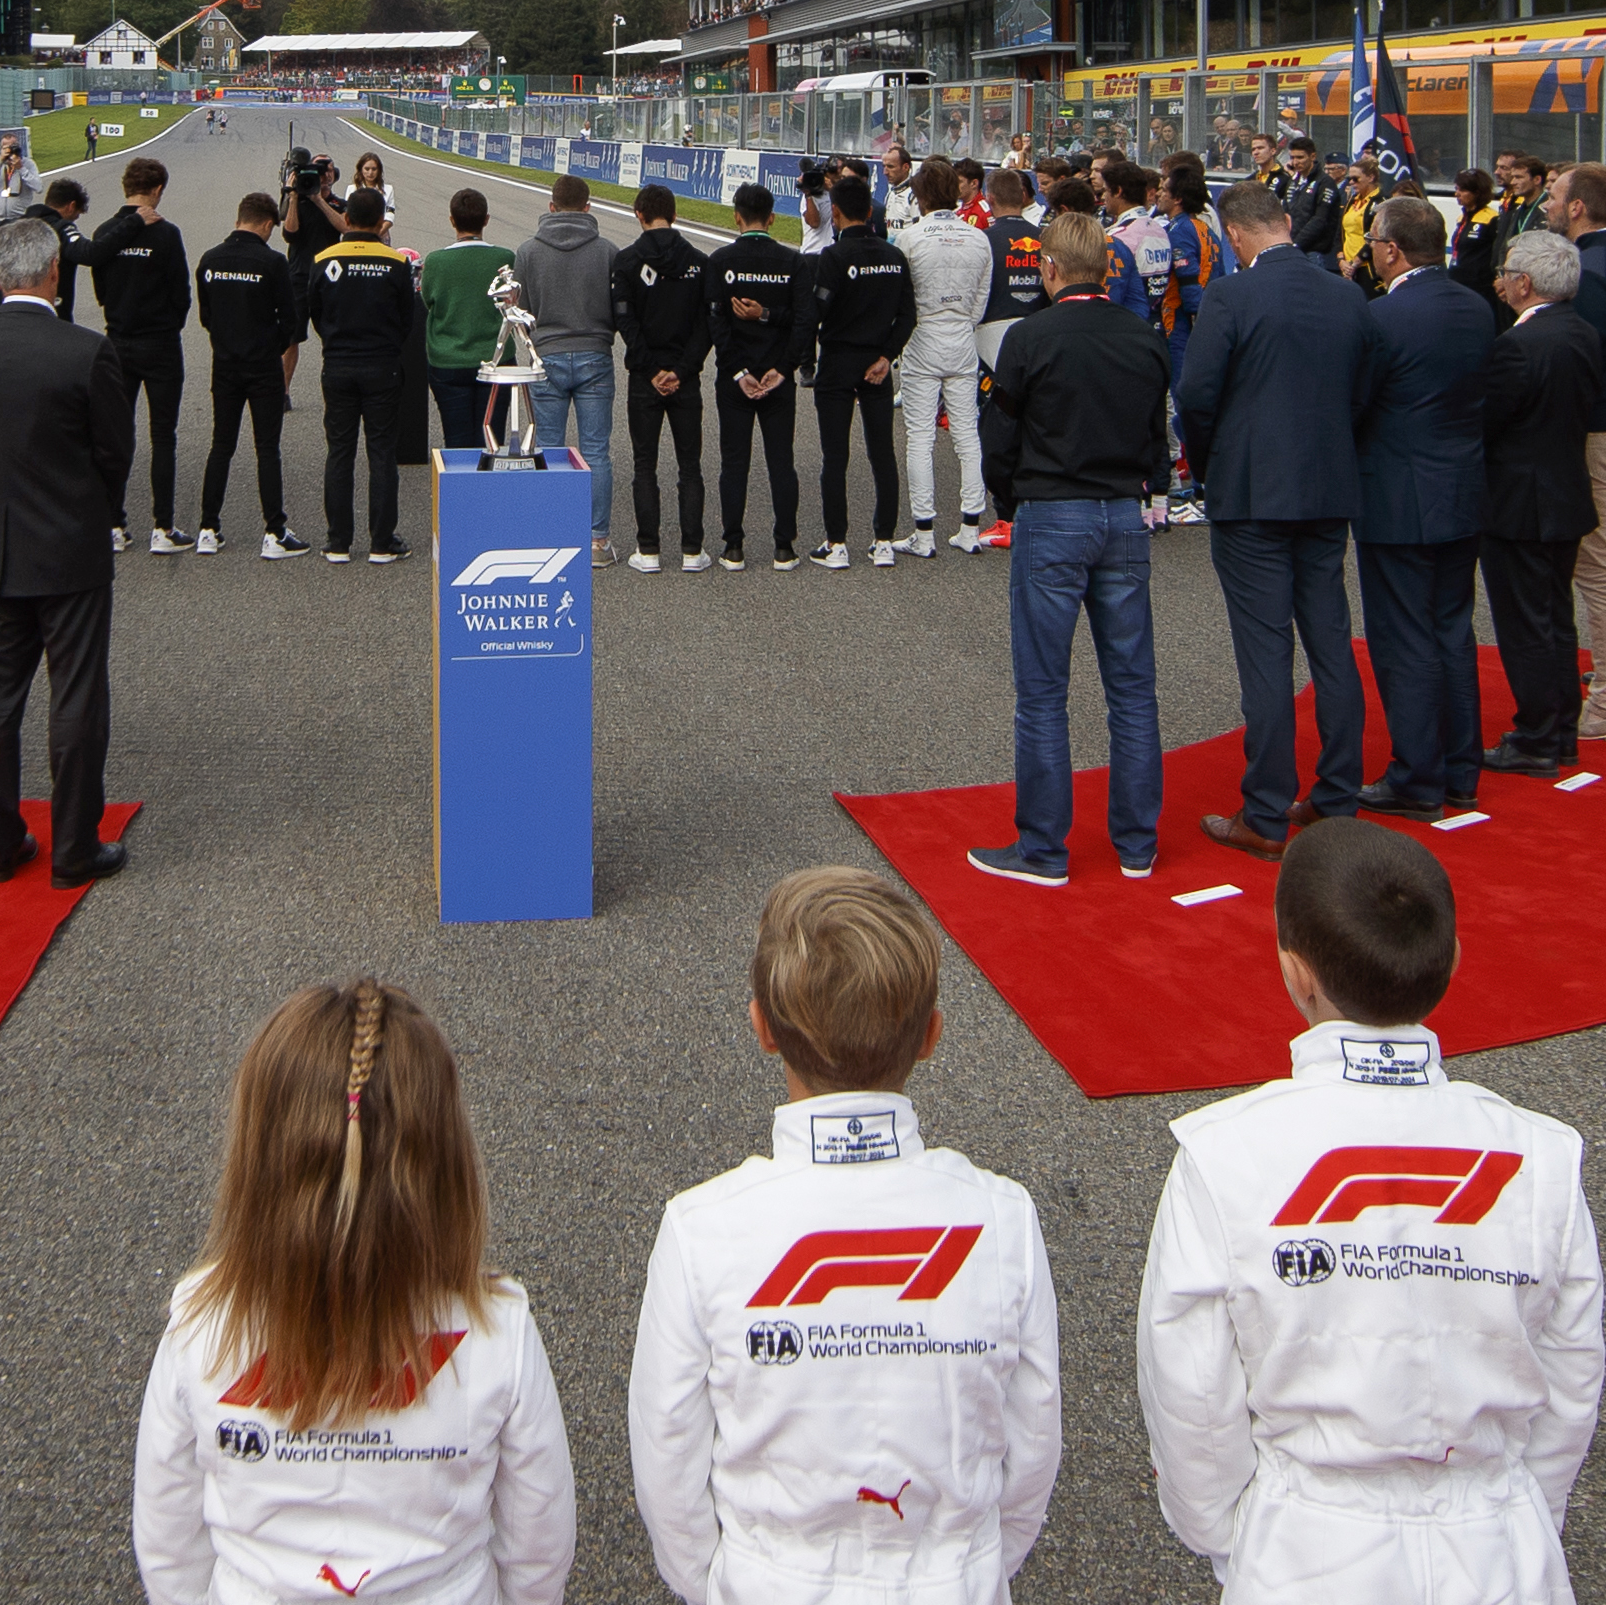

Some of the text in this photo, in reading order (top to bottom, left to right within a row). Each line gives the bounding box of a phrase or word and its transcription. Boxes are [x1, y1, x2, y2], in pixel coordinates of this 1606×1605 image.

[105, 126, 120, 134] 100
[348, 263, 392, 273] RENAULT
[1006, 255, 1028, 268] Red
[214, 271, 263, 283] RENAULT
[738, 273, 791, 284] RENAULT
[1008, 275, 1035, 286] Mobil
[457, 593, 549, 615] JOHNNIE
[464, 614, 549, 632] WALKER
[481, 640, 553, 652] Official Whisky
[1341, 1243, 1465, 1262] FIA Formula 1
[1342, 1260, 1529, 1287] World Championship
[808, 1322, 927, 1340] FIA Formula 1
[808, 1339, 988, 1359] World Championship
[275, 1429, 394, 1445] FIA Formula 1
[275, 1446, 457, 1464] World Championship
